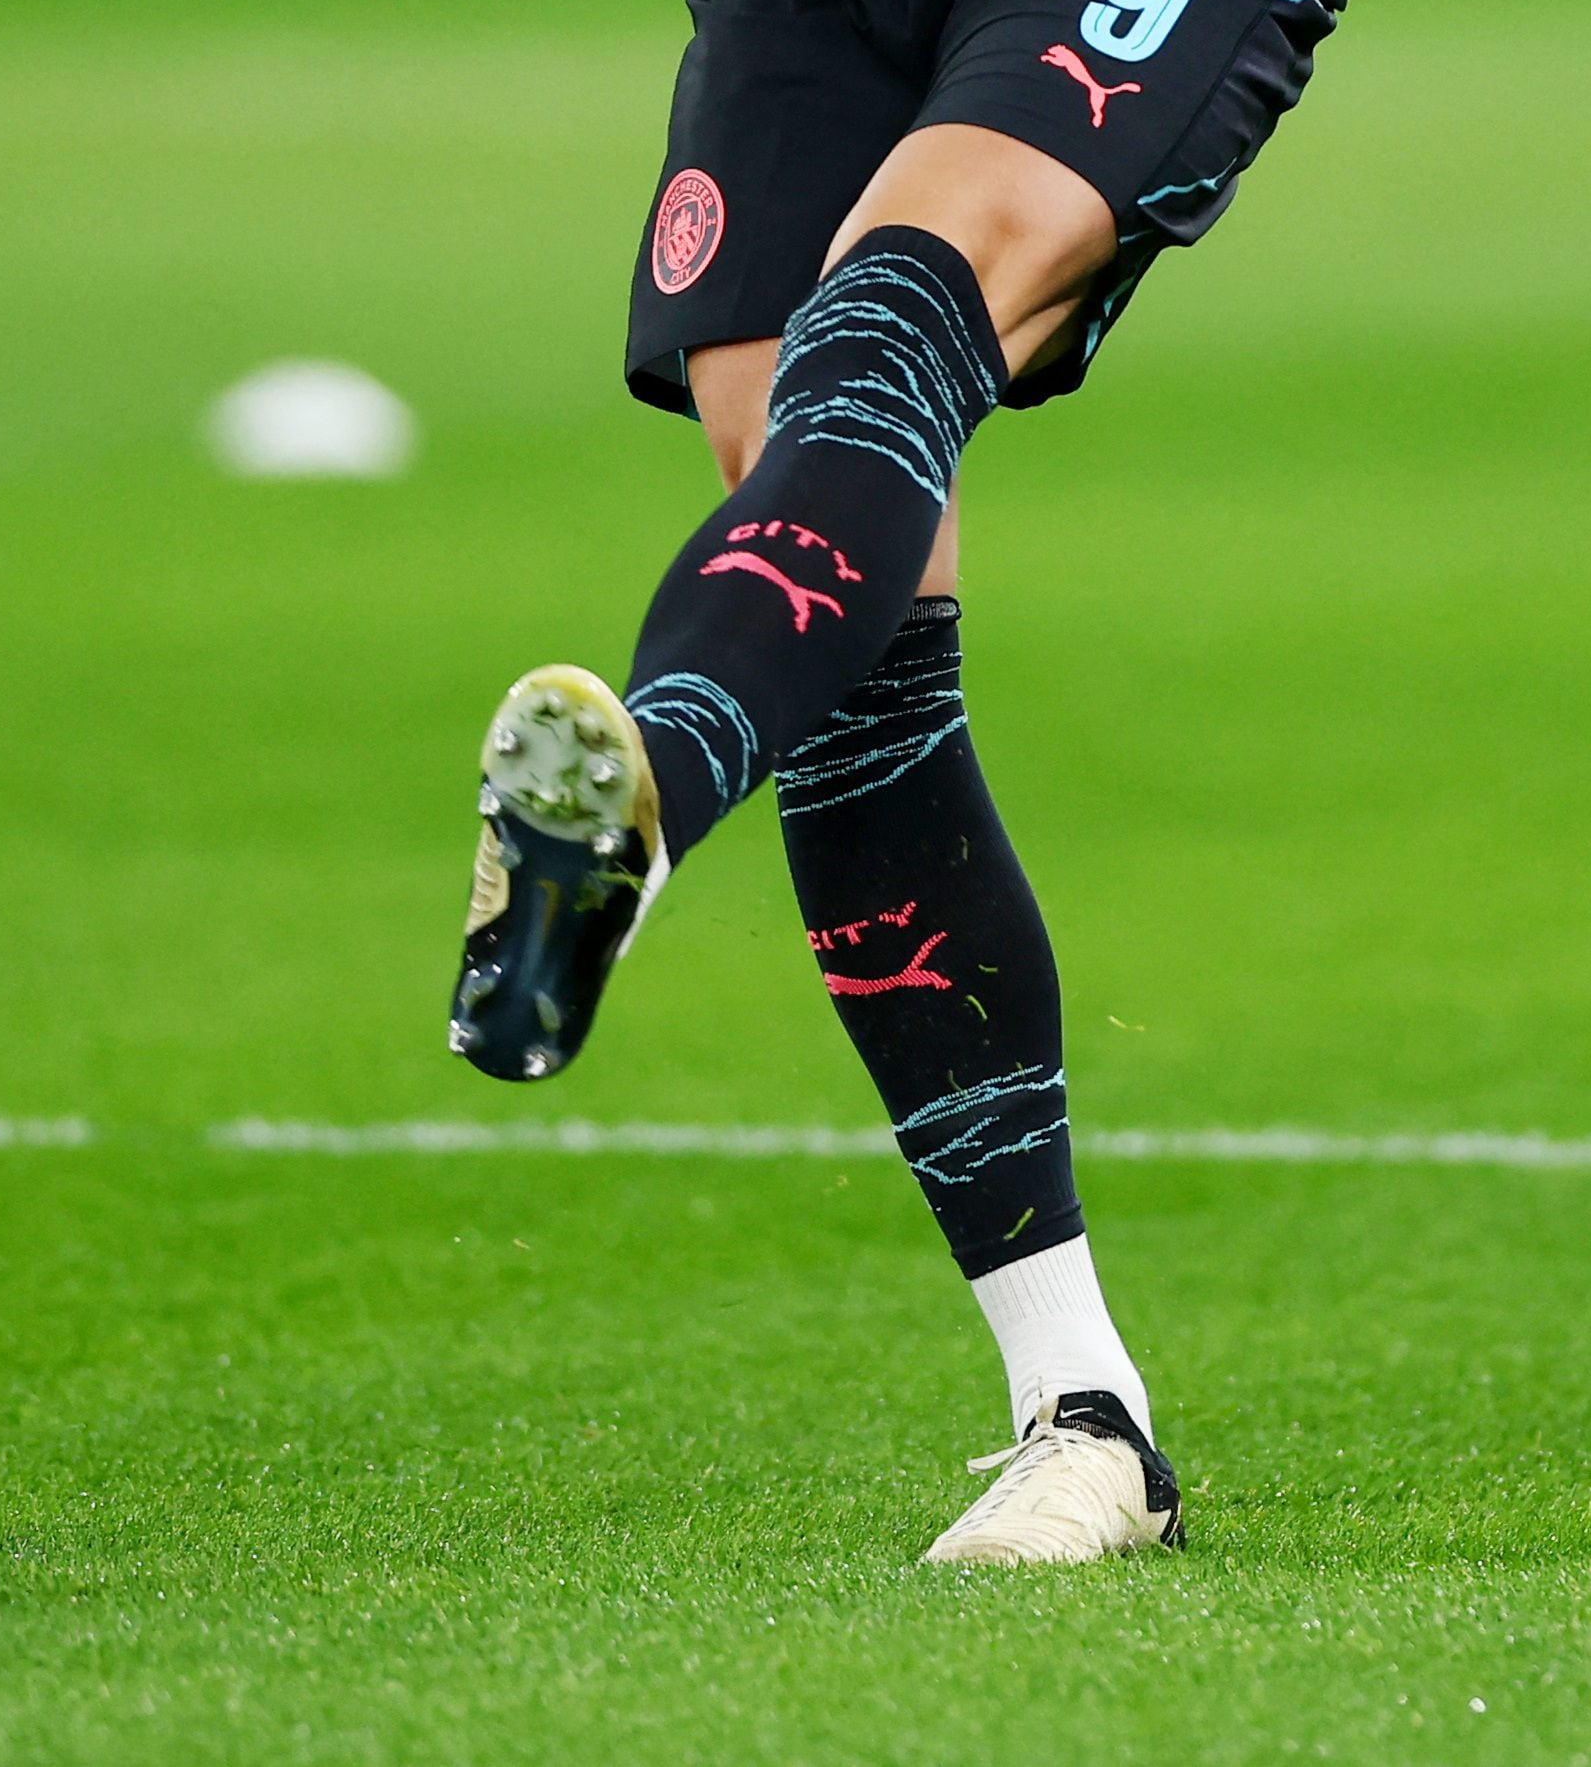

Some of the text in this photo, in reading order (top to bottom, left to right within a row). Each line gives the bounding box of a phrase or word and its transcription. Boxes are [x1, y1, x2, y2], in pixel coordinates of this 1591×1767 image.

[660, 179, 714, 227] MANCHESTER
[670, 266, 692, 285] CITY
[727, 520, 862, 582] CITY
[807, 900, 917, 950] CITY
